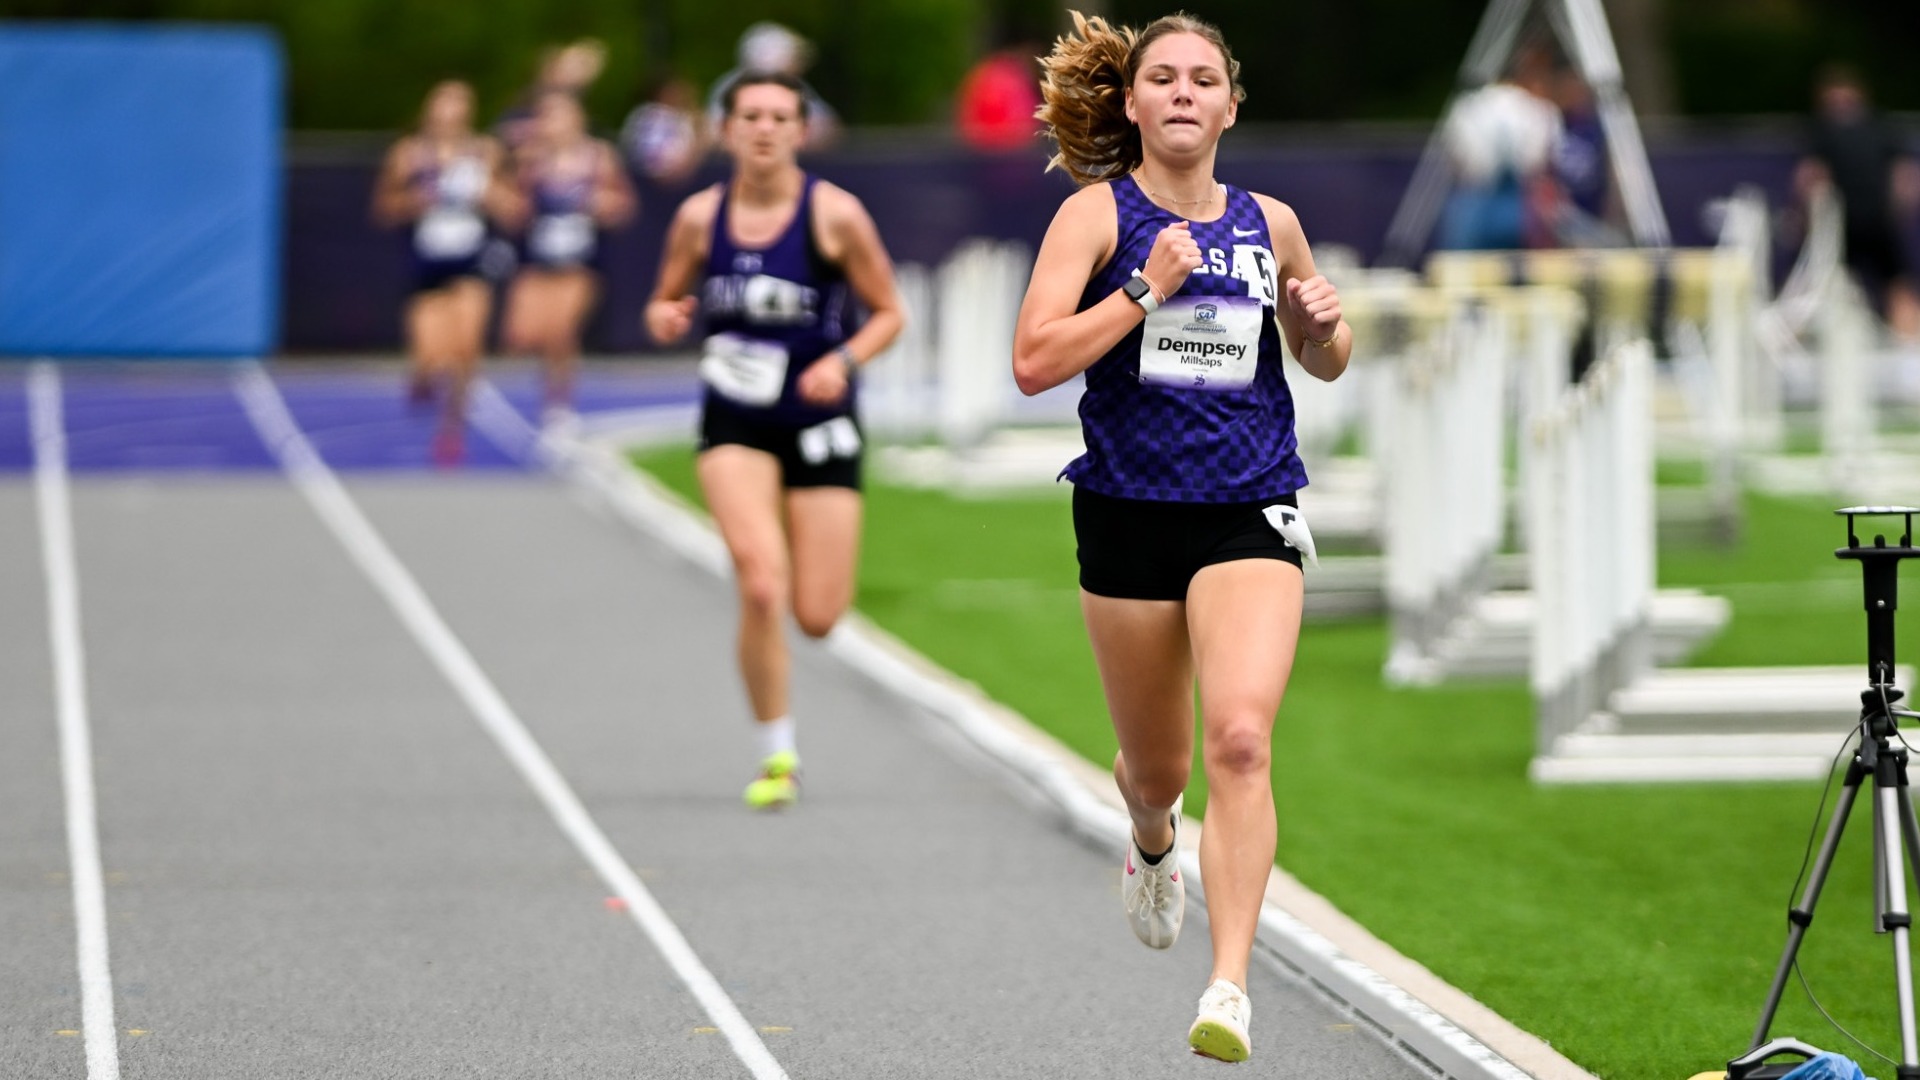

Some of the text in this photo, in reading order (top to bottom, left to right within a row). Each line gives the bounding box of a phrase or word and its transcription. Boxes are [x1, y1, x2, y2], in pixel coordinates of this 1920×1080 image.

[1252, 251, 1275, 301] 5
[1198, 311, 1216, 320] SAA
[1158, 337, 1247, 360] Dempsey
[1180, 354, 1223, 368] Millsaps
